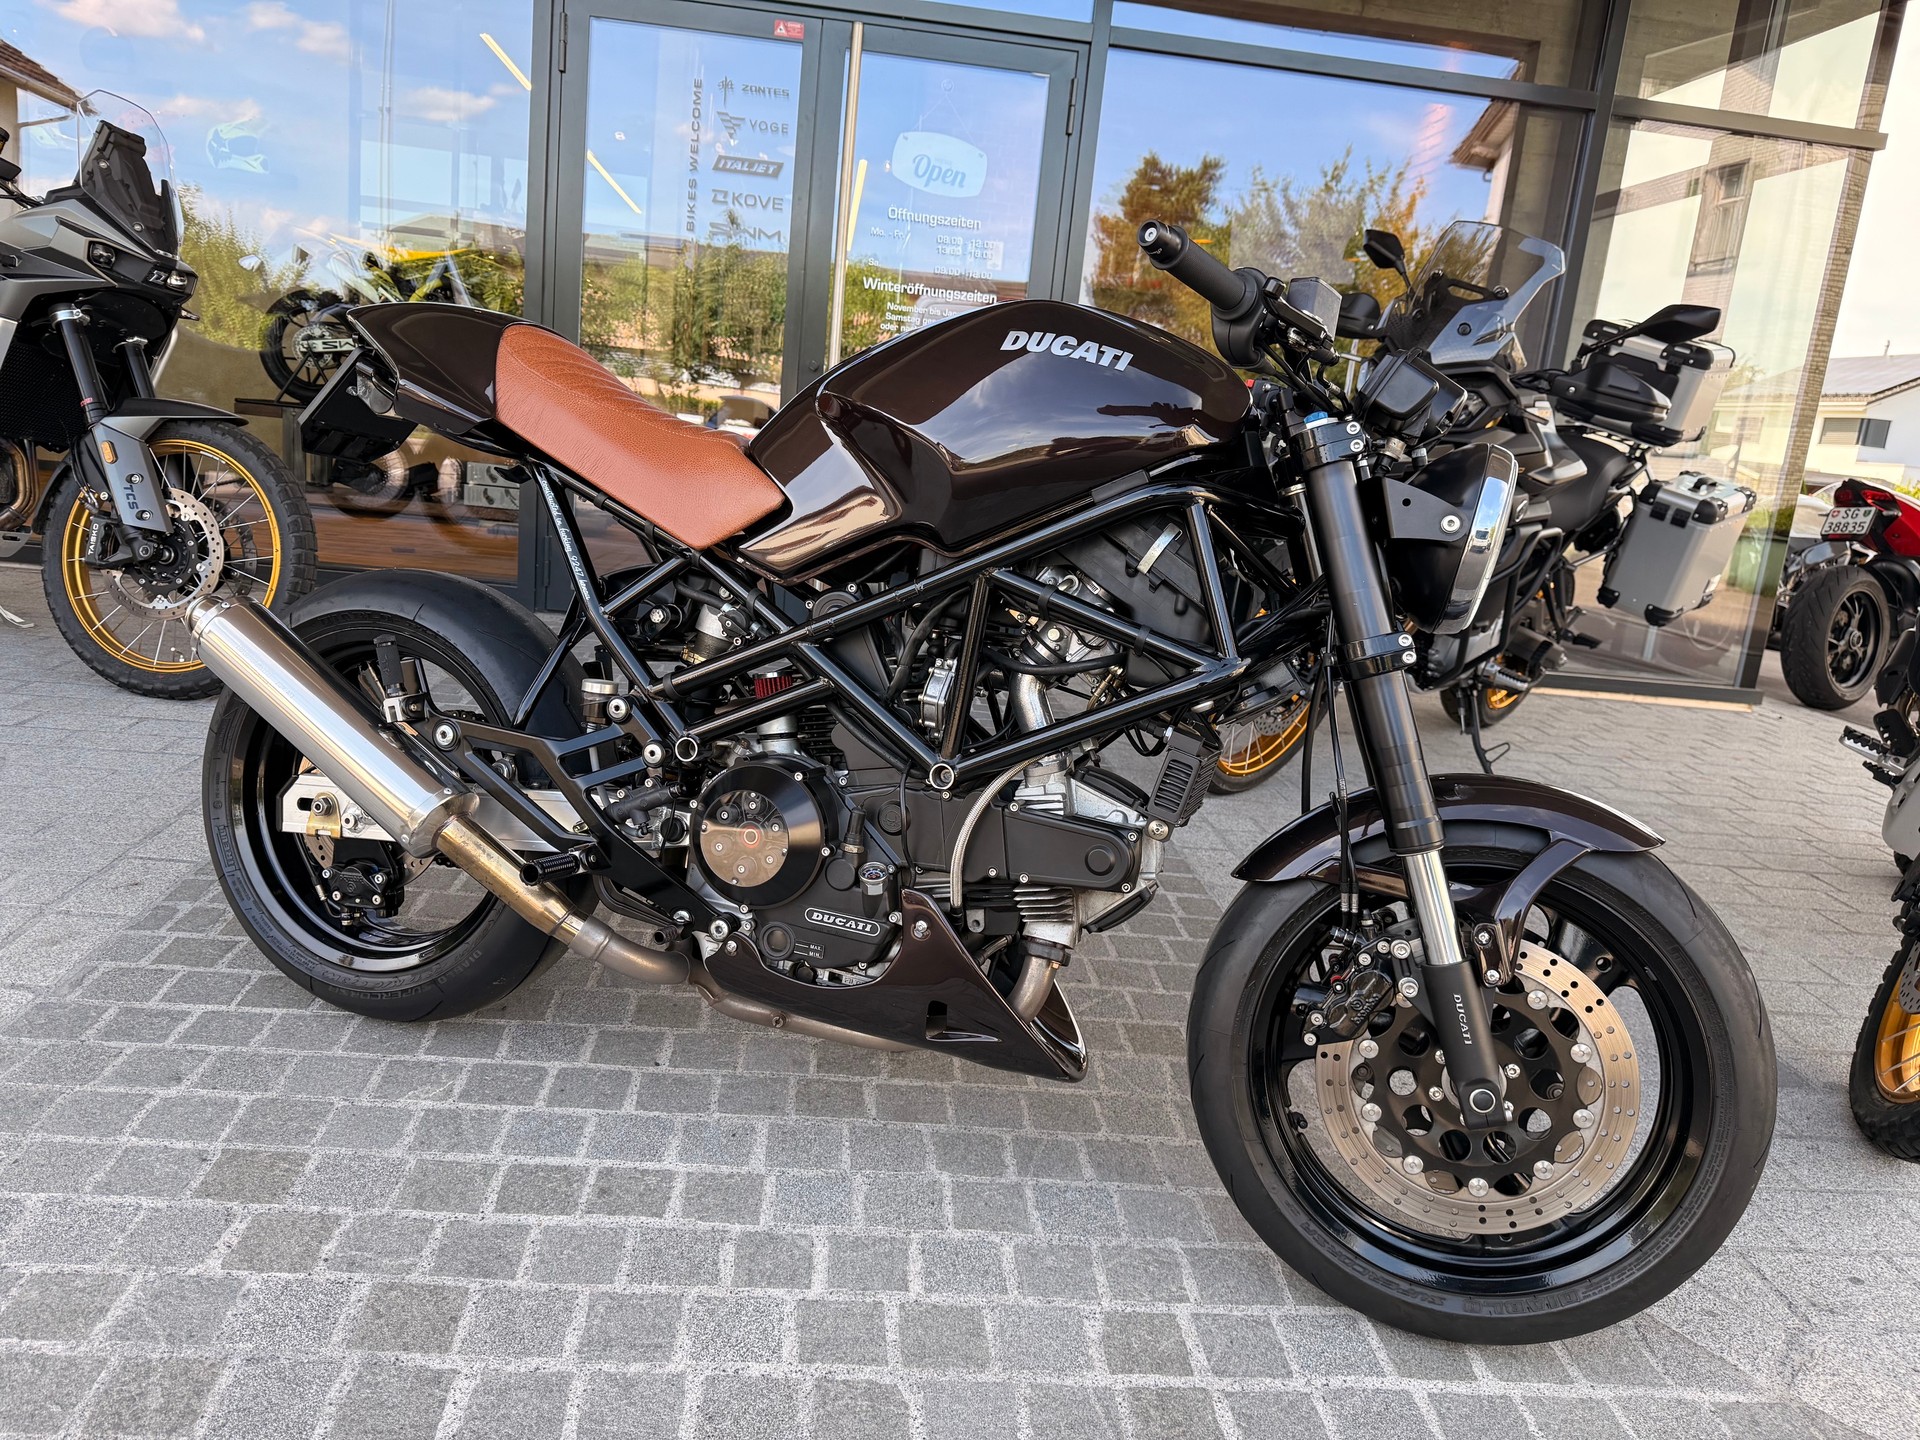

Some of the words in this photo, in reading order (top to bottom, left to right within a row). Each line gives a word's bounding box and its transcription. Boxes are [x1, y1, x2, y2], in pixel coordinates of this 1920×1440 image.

[741, 84, 790, 97] ZONTES
[689, 78, 702, 172] WELCOME
[749, 119, 789, 134] VOGE
[718, 158, 778, 174] ITALJET
[913, 153, 966, 188] Open
[686, 178, 697, 232] BIKES
[732, 192, 783, 211] KOVE
[888, 204, 982, 230] Öffnungszeiten
[863, 276, 997, 304] Winteröffnungszeiten
[885, 312, 920, 325] Samstag
[887, 302, 927, 314] November
[929, 306, 941, 315] bis
[880, 322, 899, 331] oder
[1000, 330, 1134, 372] DUCATI
[123, 484, 139, 510] TCS
[1824, 521, 1867, 533] 38835
[1842, 508, 1861, 520] SG
[88, 523, 99, 556] TAISKO
[541, 480, 562, 518] constructed
[555, 517, 563, 526] in
[560, 528, 572, 553] fucking
[571, 555, 585, 578] 9247
[811, 911, 872, 932] DUCATI
[437, 949, 483, 984] DIABLO
[1453, 993, 1473, 1045] DUCATI
[1300, 1221, 1446, 1306] SUPERCORSA
[1463, 1289, 1578, 1315] DIABLO
